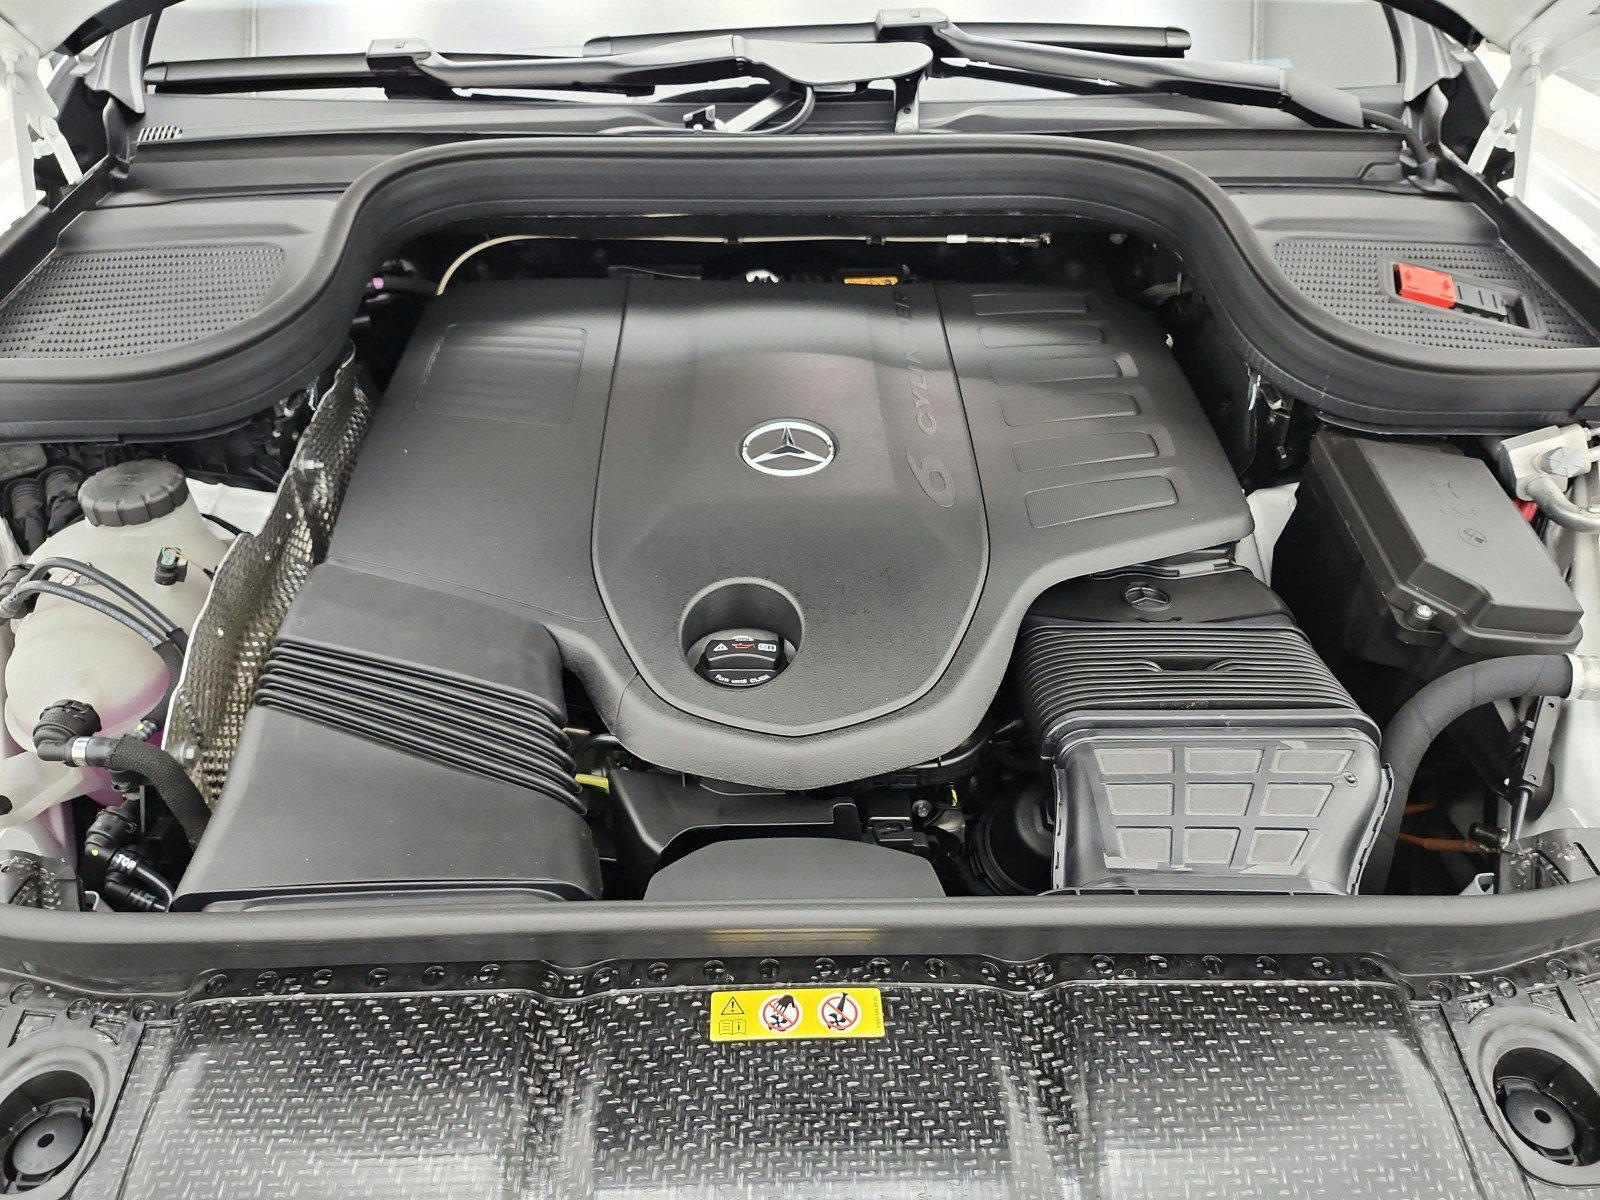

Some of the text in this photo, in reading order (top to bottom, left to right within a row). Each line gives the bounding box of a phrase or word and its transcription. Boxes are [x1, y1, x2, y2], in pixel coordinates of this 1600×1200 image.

[892, 290, 956, 508] 6 CYLINDER
[715, 674, 730, 682] Turn
[750, 674, 770, 683] CLICK
[116, 853, 137, 869] TOP
